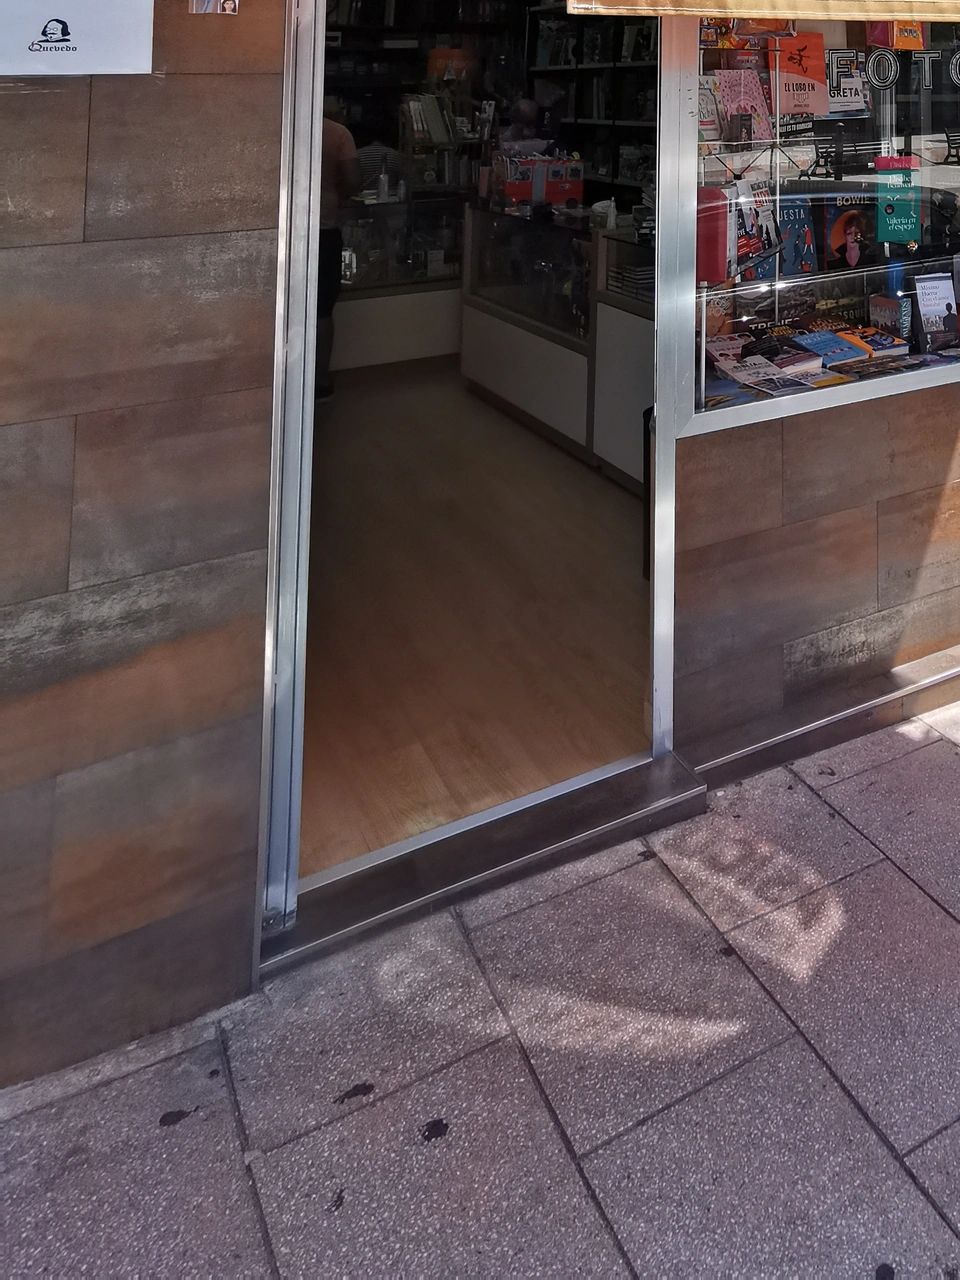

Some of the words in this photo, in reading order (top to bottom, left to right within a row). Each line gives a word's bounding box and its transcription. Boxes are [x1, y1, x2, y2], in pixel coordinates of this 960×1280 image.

[28, 39, 78, 53] Quevedo
[829, 87, 860, 98] GRETA
[836, 194, 871, 207] BOWIE
